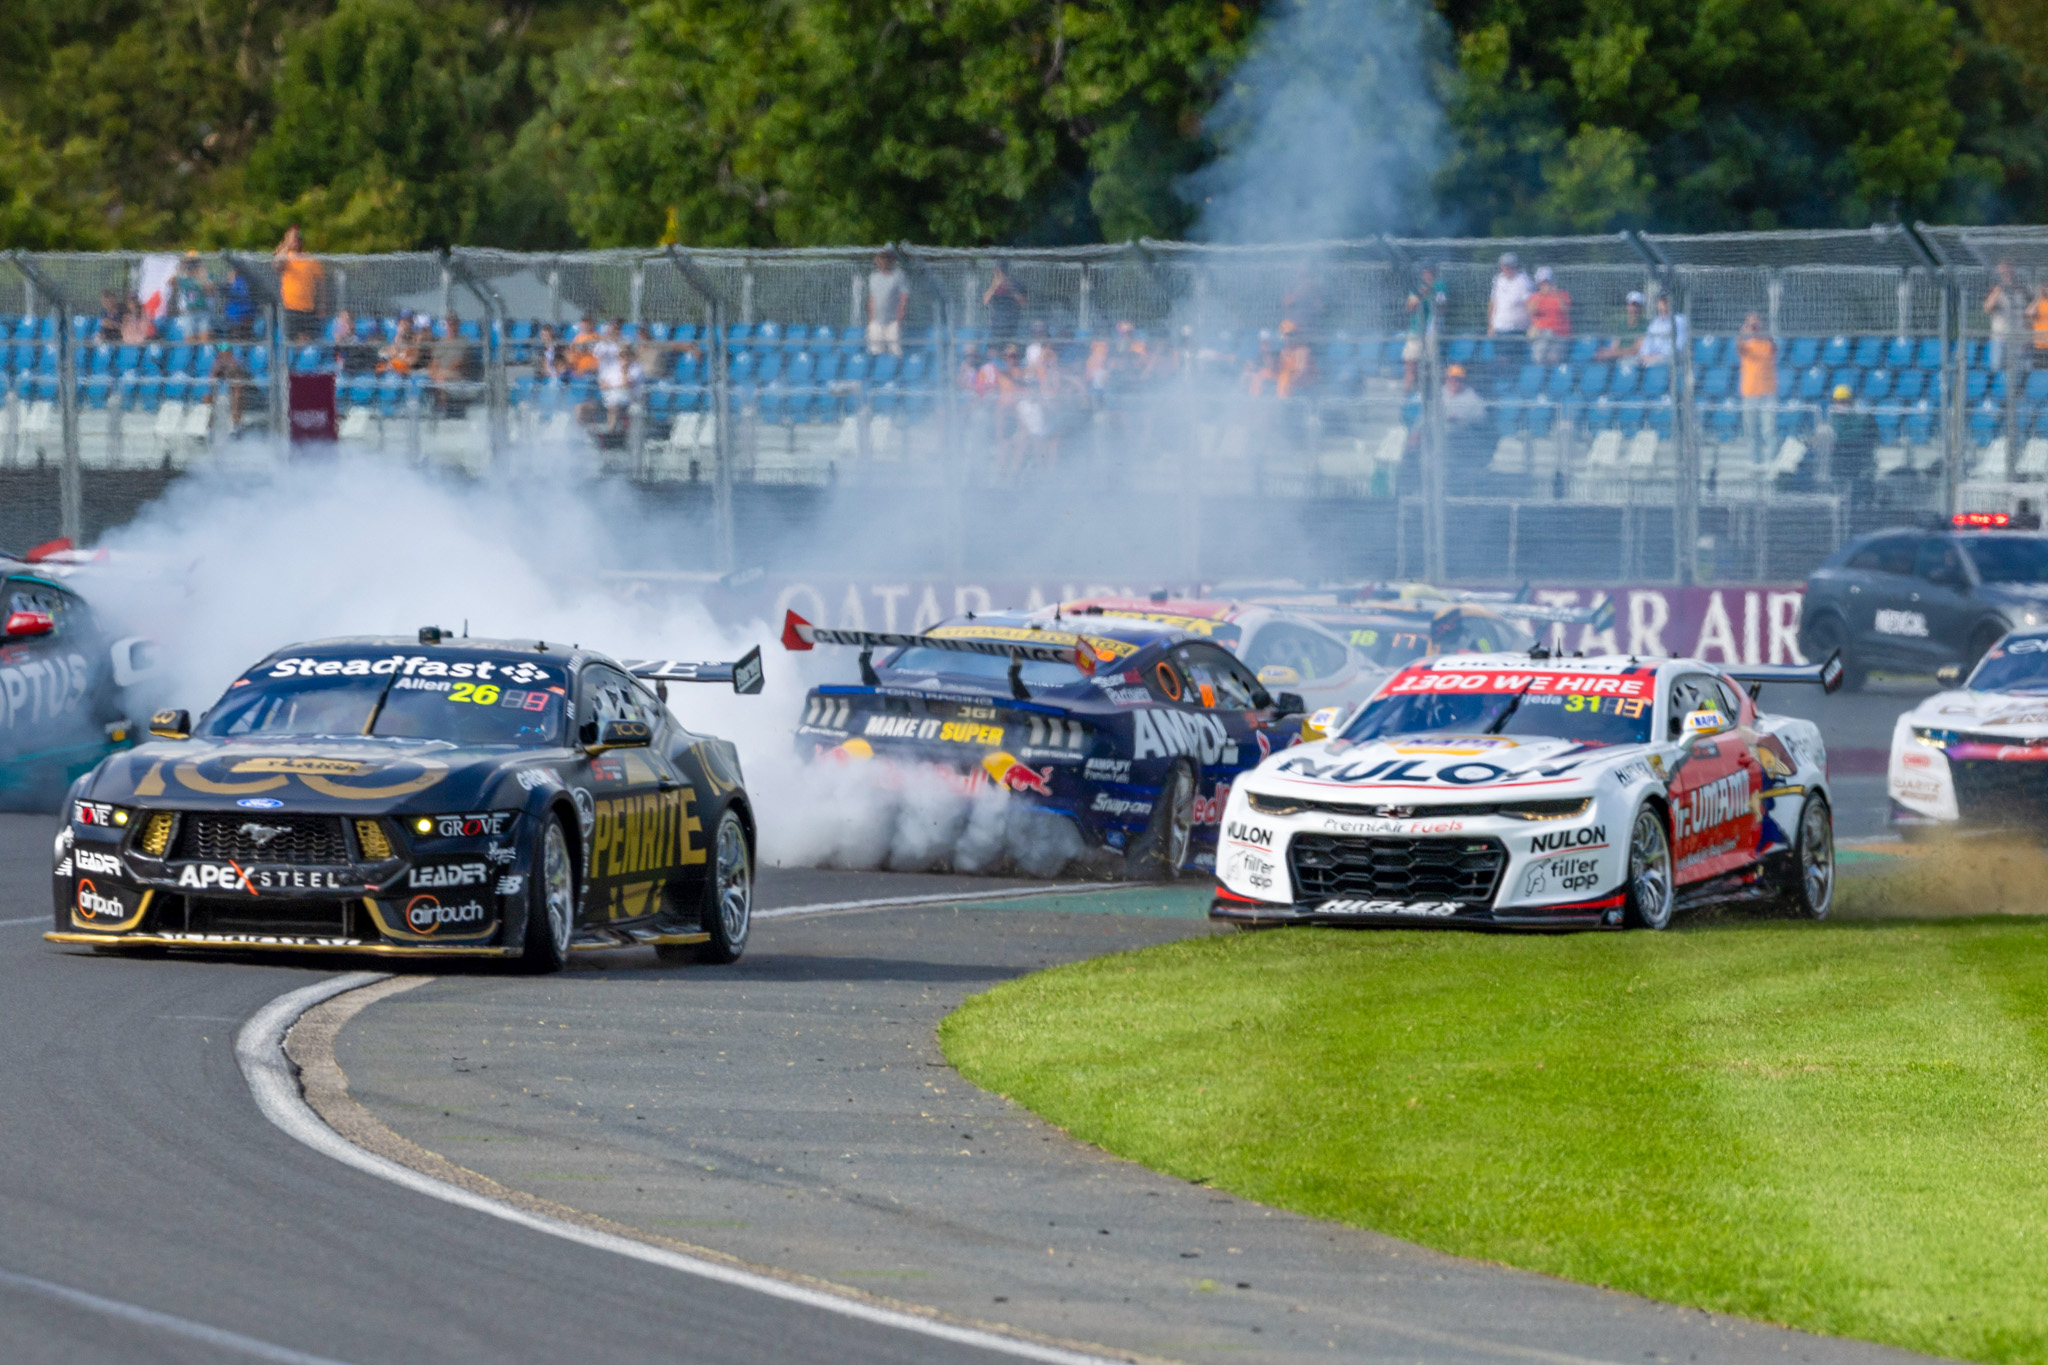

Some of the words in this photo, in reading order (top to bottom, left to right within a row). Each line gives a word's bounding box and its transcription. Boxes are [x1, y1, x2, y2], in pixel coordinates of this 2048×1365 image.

[1350, 629, 1378, 646] 18
[268, 655, 497, 681] Steadfast
[0, 652, 87, 730] PTUS
[394, 677, 451, 692] Allen
[447, 682, 501, 706] 26
[1391, 674, 1489, 692] 1300
[1492, 676, 1548, 691] WE
[1554, 677, 1644, 695] HIRE
[1564, 695, 1602, 712] 31
[613, 723, 648, 737] 100
[864, 715, 918, 738] MAKE
[917, 718, 943, 740] IT
[939, 721, 1005, 747] SUPER
[1694, 714, 1721, 727] NAPA
[1090, 793, 1153, 814] Snap-on
[438, 818, 503, 837] GROVE
[591, 787, 707, 879] PENRITE
[1323, 817, 1403, 834] PremiAir
[1409, 820, 1463, 834] Fuels
[1530, 825, 1607, 854] NULON
[178, 859, 260, 897] APEX
[260, 871, 341, 889] STEEL
[408, 862, 488, 888] LEADER
[1250, 876, 1273, 889] app
[1562, 873, 1600, 891] app
[410, 899, 485, 926] airtouch
